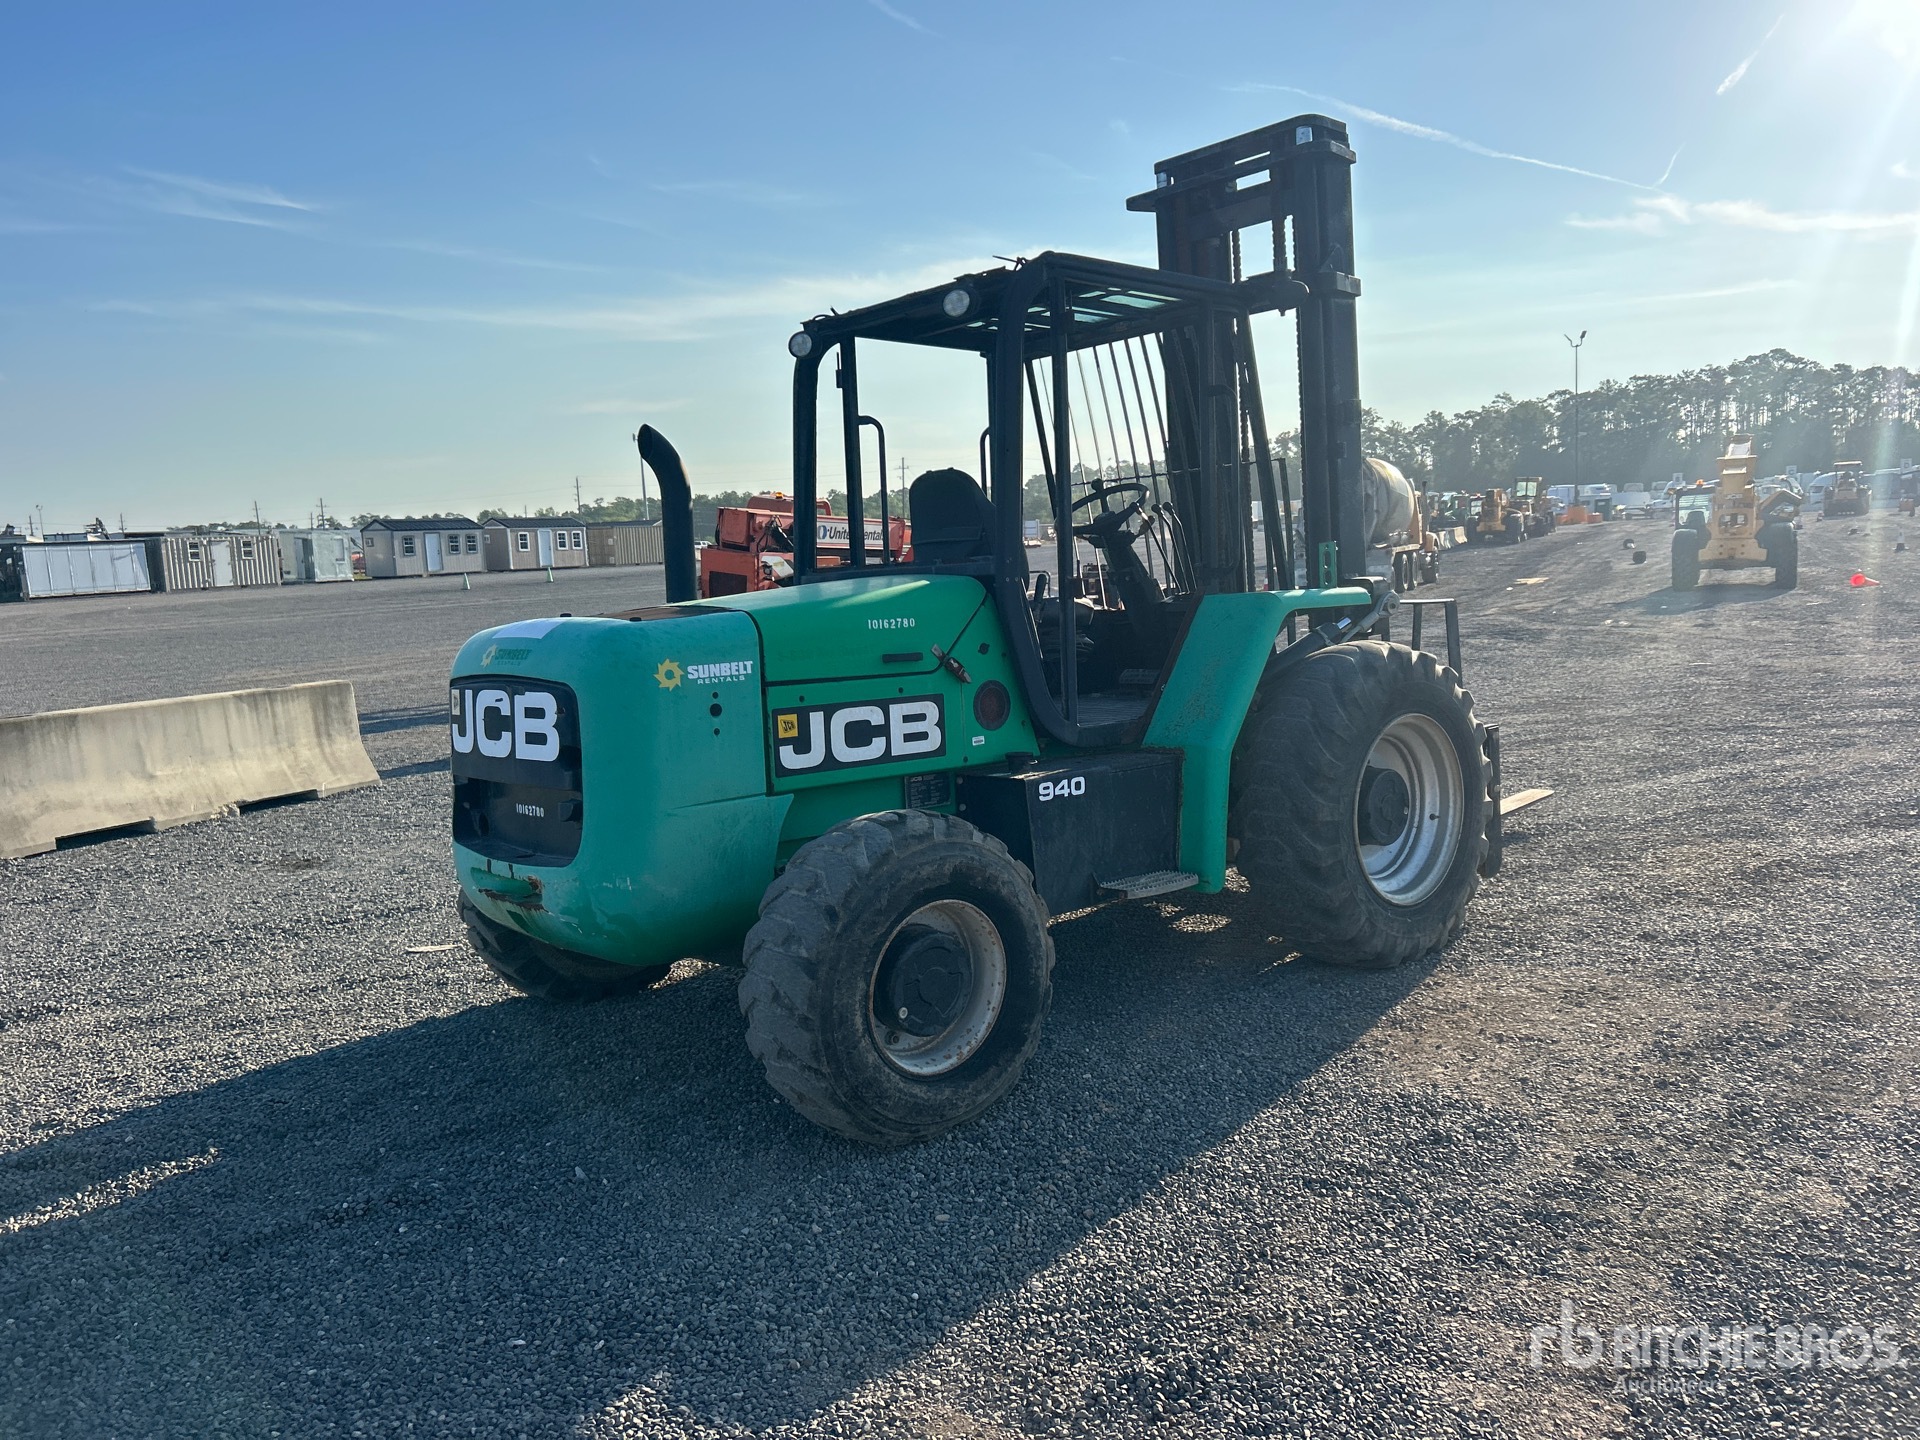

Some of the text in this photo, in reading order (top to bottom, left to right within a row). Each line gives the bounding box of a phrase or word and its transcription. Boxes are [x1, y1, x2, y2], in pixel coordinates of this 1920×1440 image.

[829, 527, 883, 541] Unite ental
[867, 617, 916, 630] 10162780
[687, 660, 753, 679] SUNBELT
[697, 675, 746, 684] RENTALS
[451, 688, 560, 762] JCB
[778, 700, 942, 770] JCB
[1038, 776, 1086, 802] 940
[515, 803, 545, 818] 10162780
